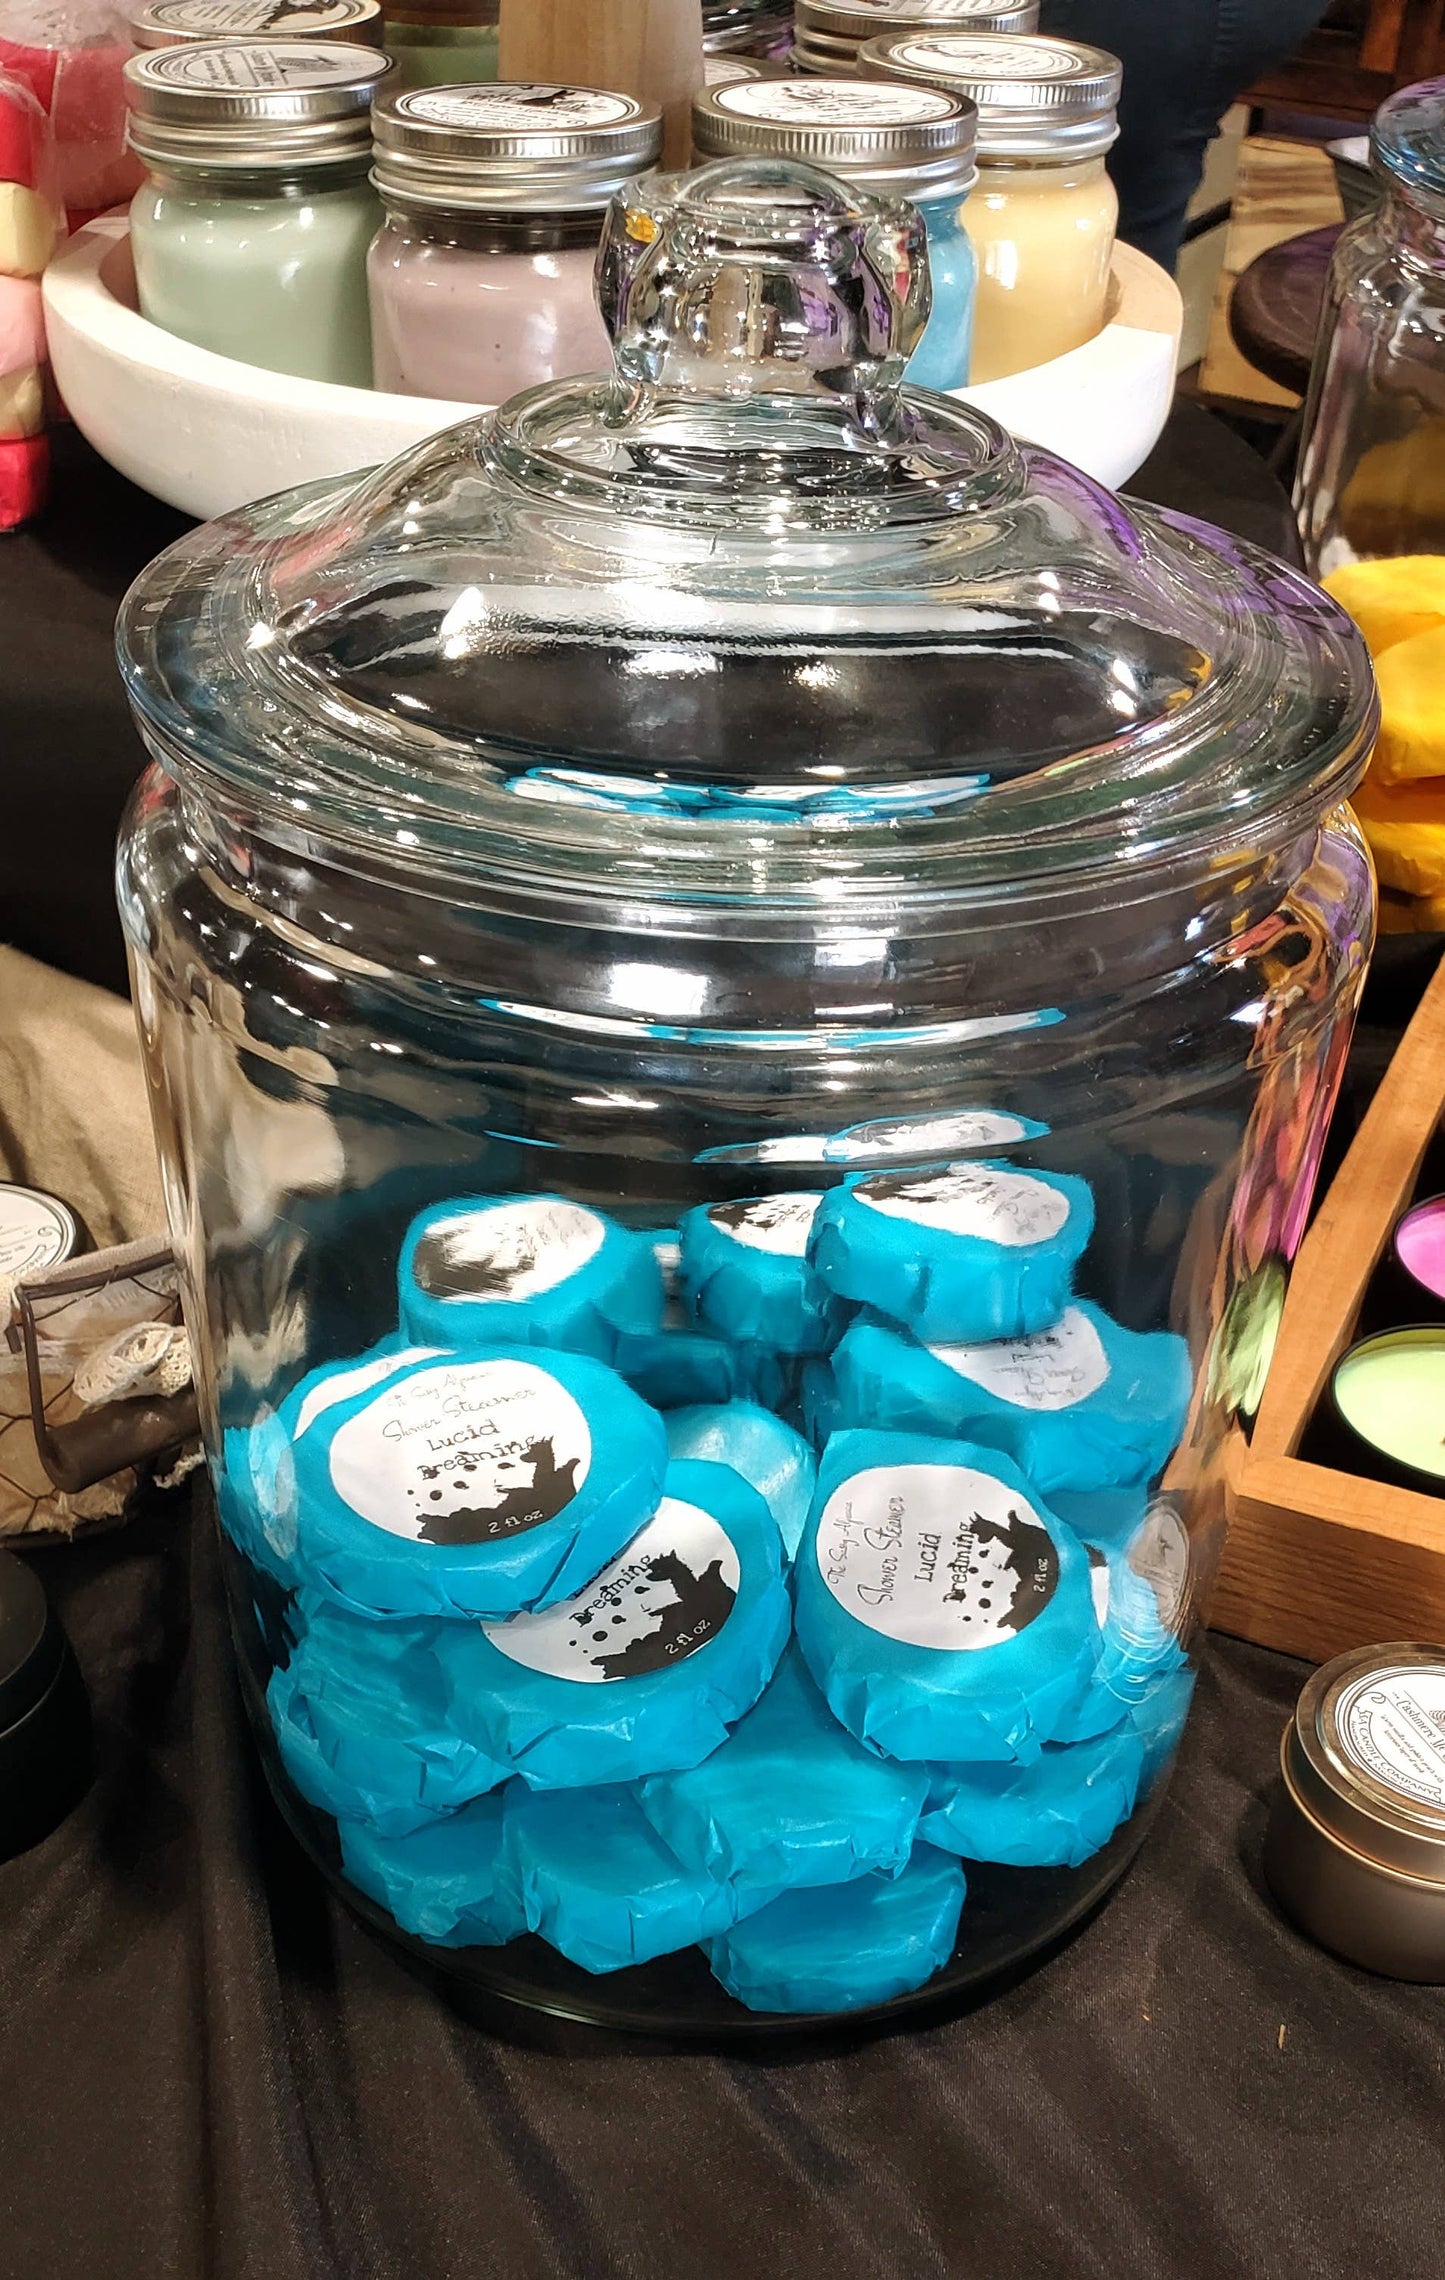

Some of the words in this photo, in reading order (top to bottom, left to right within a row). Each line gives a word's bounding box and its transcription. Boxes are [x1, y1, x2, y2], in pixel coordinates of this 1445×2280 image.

[427, 1419, 501, 1452] Lucid
[488, 1521, 501, 1534] 2
[504, 1515, 521, 1528] fl
[523, 1509, 544, 1522] oz
[863, 1496, 905, 1551] Steamer
[914, 1532, 942, 1583] Lucid
[1038, 1558, 1049, 1572] oz
[857, 1556, 898, 1606] Shower
[1033, 1584, 1046, 1592] 2
[664, 1643, 680, 1655] 2
[676, 1632, 694, 1646] fl
[693, 1619, 711, 1635] oz
[1396, 1700, 1437, 1738] Cashmere
[1380, 1761, 1434, 1795] COMPANY
